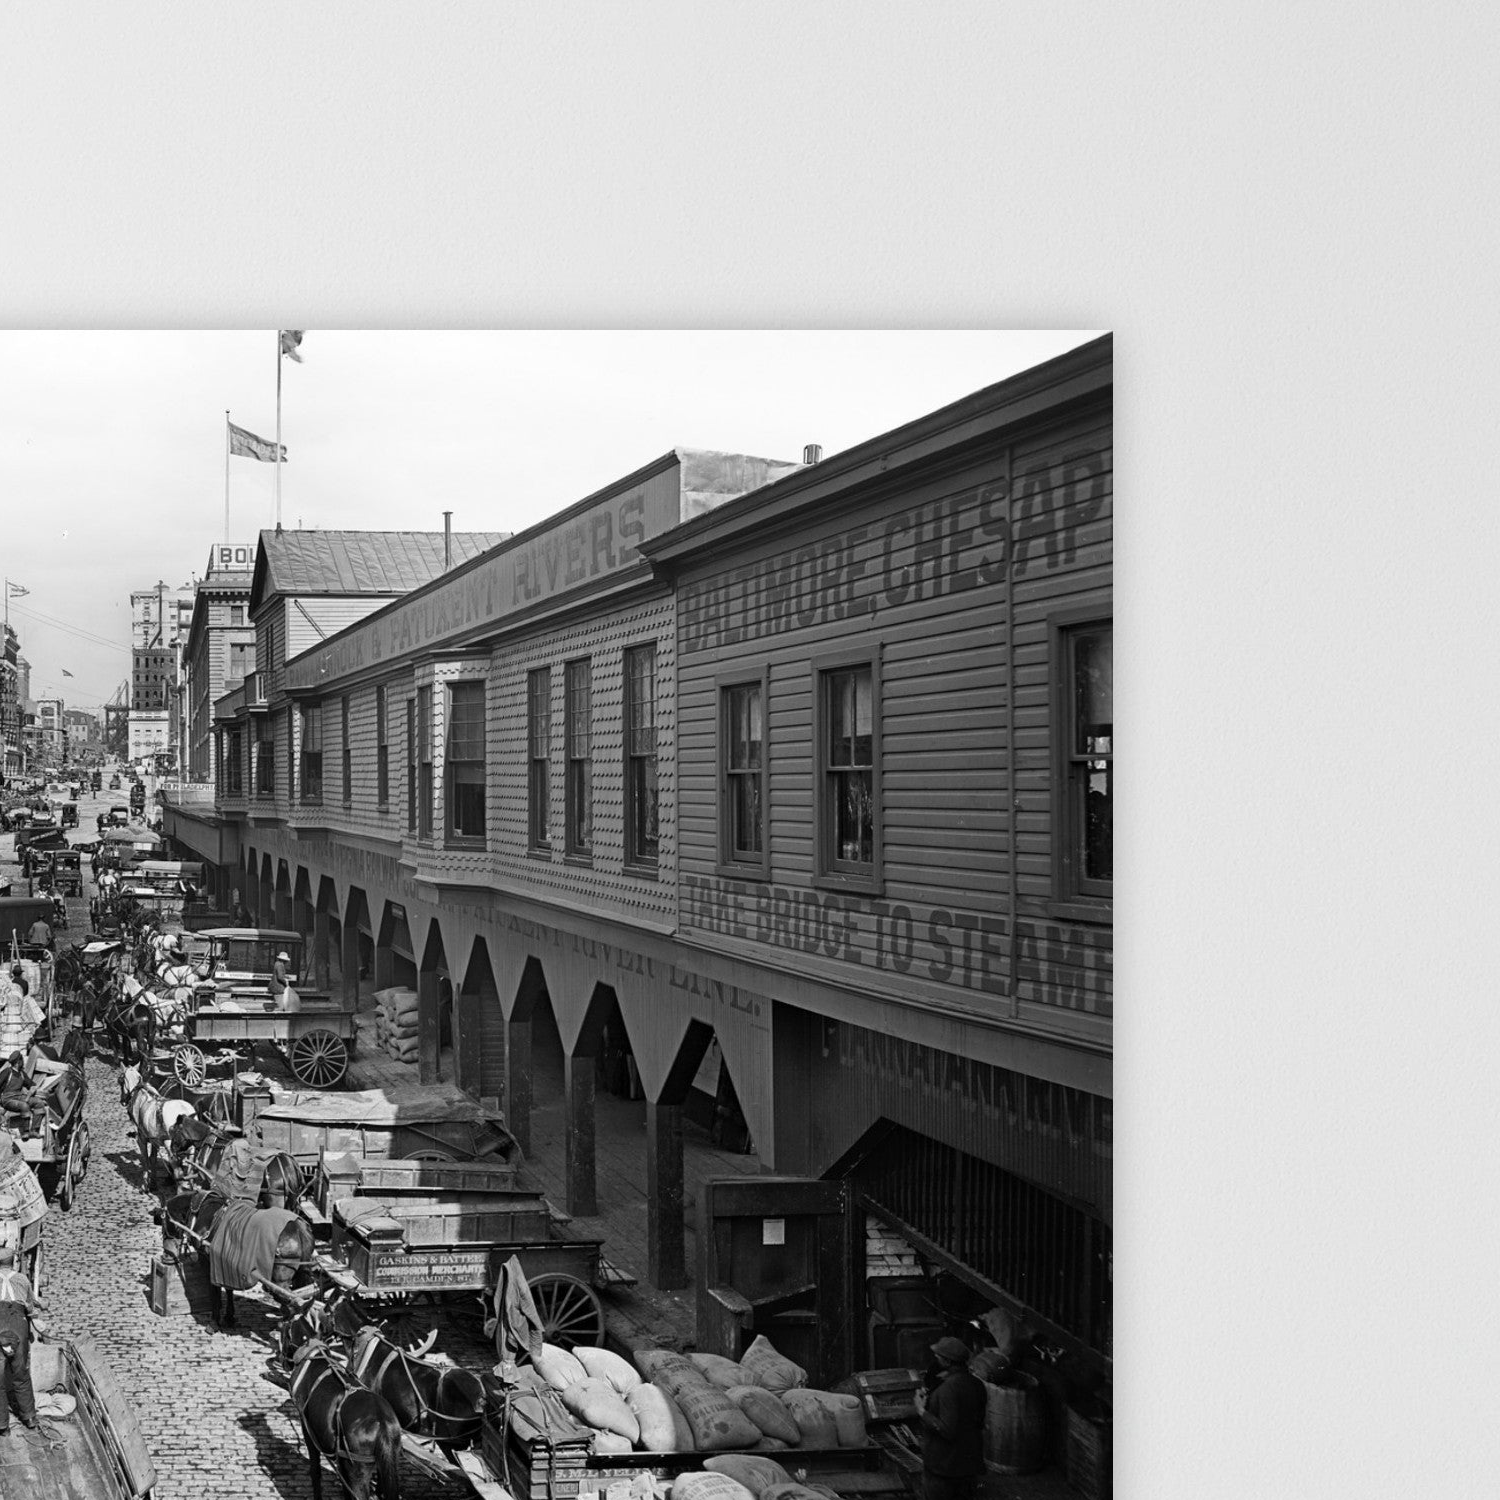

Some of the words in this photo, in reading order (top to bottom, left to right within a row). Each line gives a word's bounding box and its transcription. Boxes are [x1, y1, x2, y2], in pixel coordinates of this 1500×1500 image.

[512, 494, 645, 606] RIVERS
[685, 876, 748, 947] TAKE
[756, 884, 863, 965] BRIDGE
[870, 901, 914, 973] TO
[376, 1266, 429, 1277] COMMISSION
[379, 1256, 428, 1266] GASKINS
[430, 1256, 439, 1265] &
